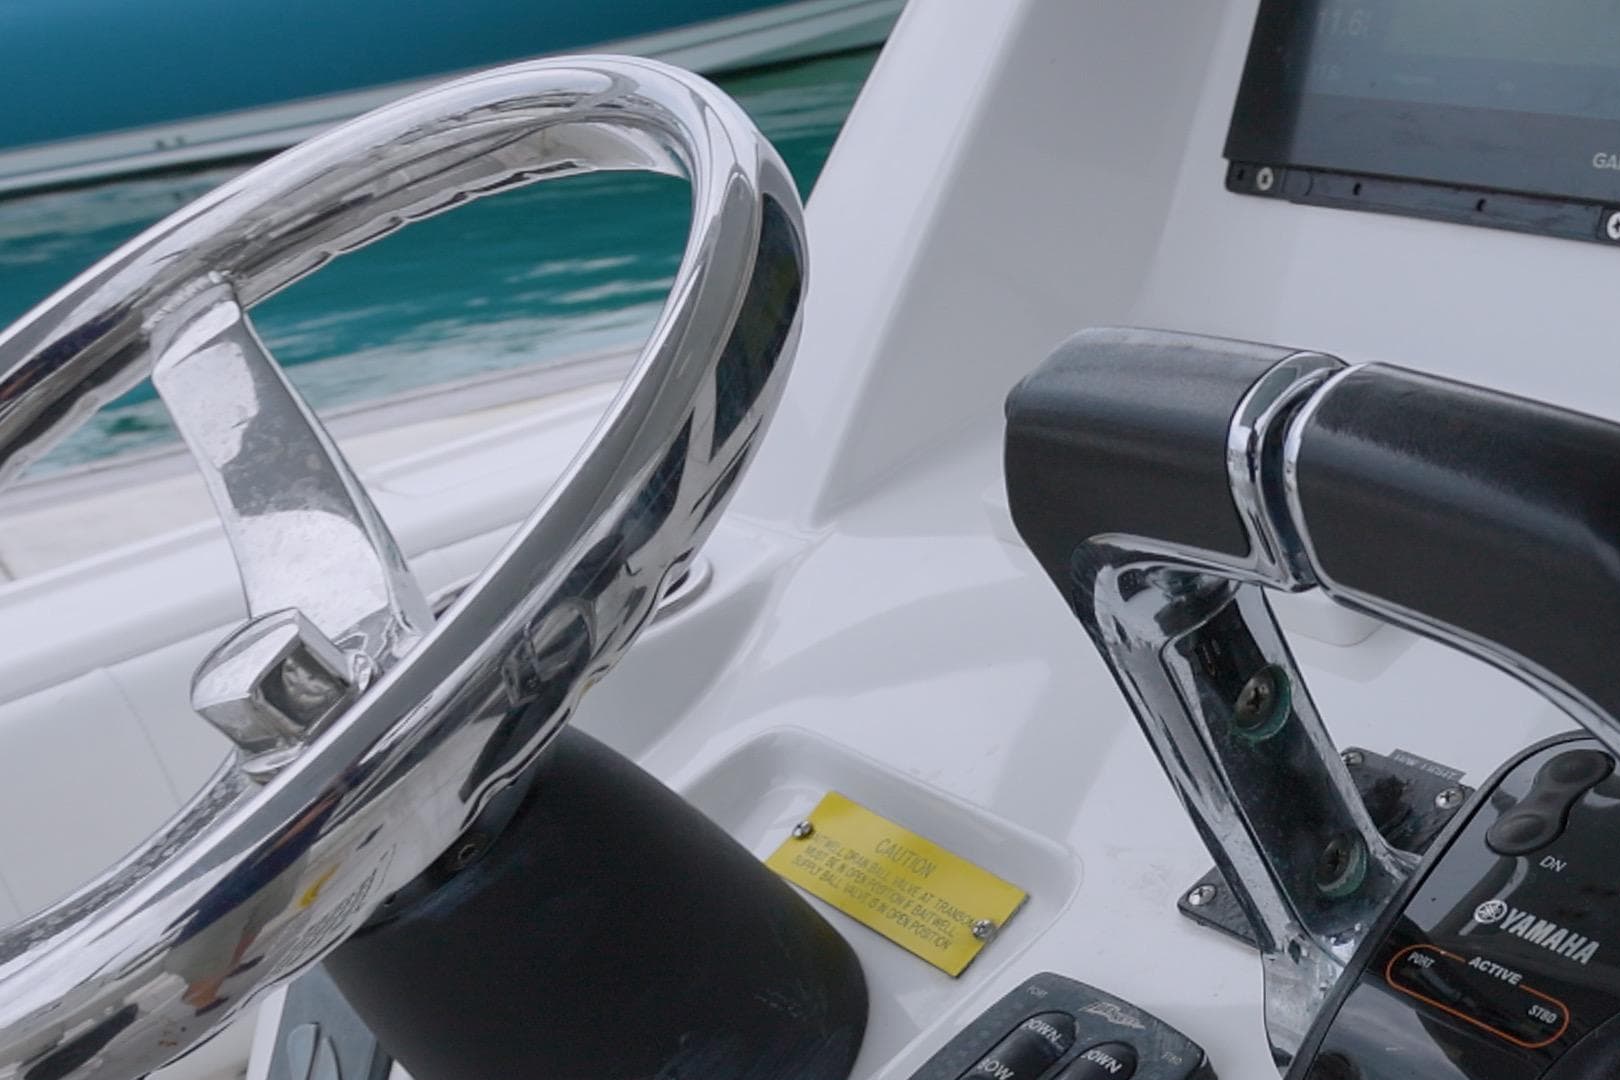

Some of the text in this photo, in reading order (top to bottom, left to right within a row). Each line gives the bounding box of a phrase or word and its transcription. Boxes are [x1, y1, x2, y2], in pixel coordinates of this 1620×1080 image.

[874, 838, 937, 879] CAUTION
[1540, 855, 1568, 873] DN
[935, 898, 975, 927] TRANSO
[1499, 907, 1600, 966] YAMAHA
[1407, 951, 1436, 969] PORT
[1468, 956, 1524, 986] ACTIVE
[1528, 1004, 1558, 1025] STBD
[1081, 1050, 1123, 1075] OWN
